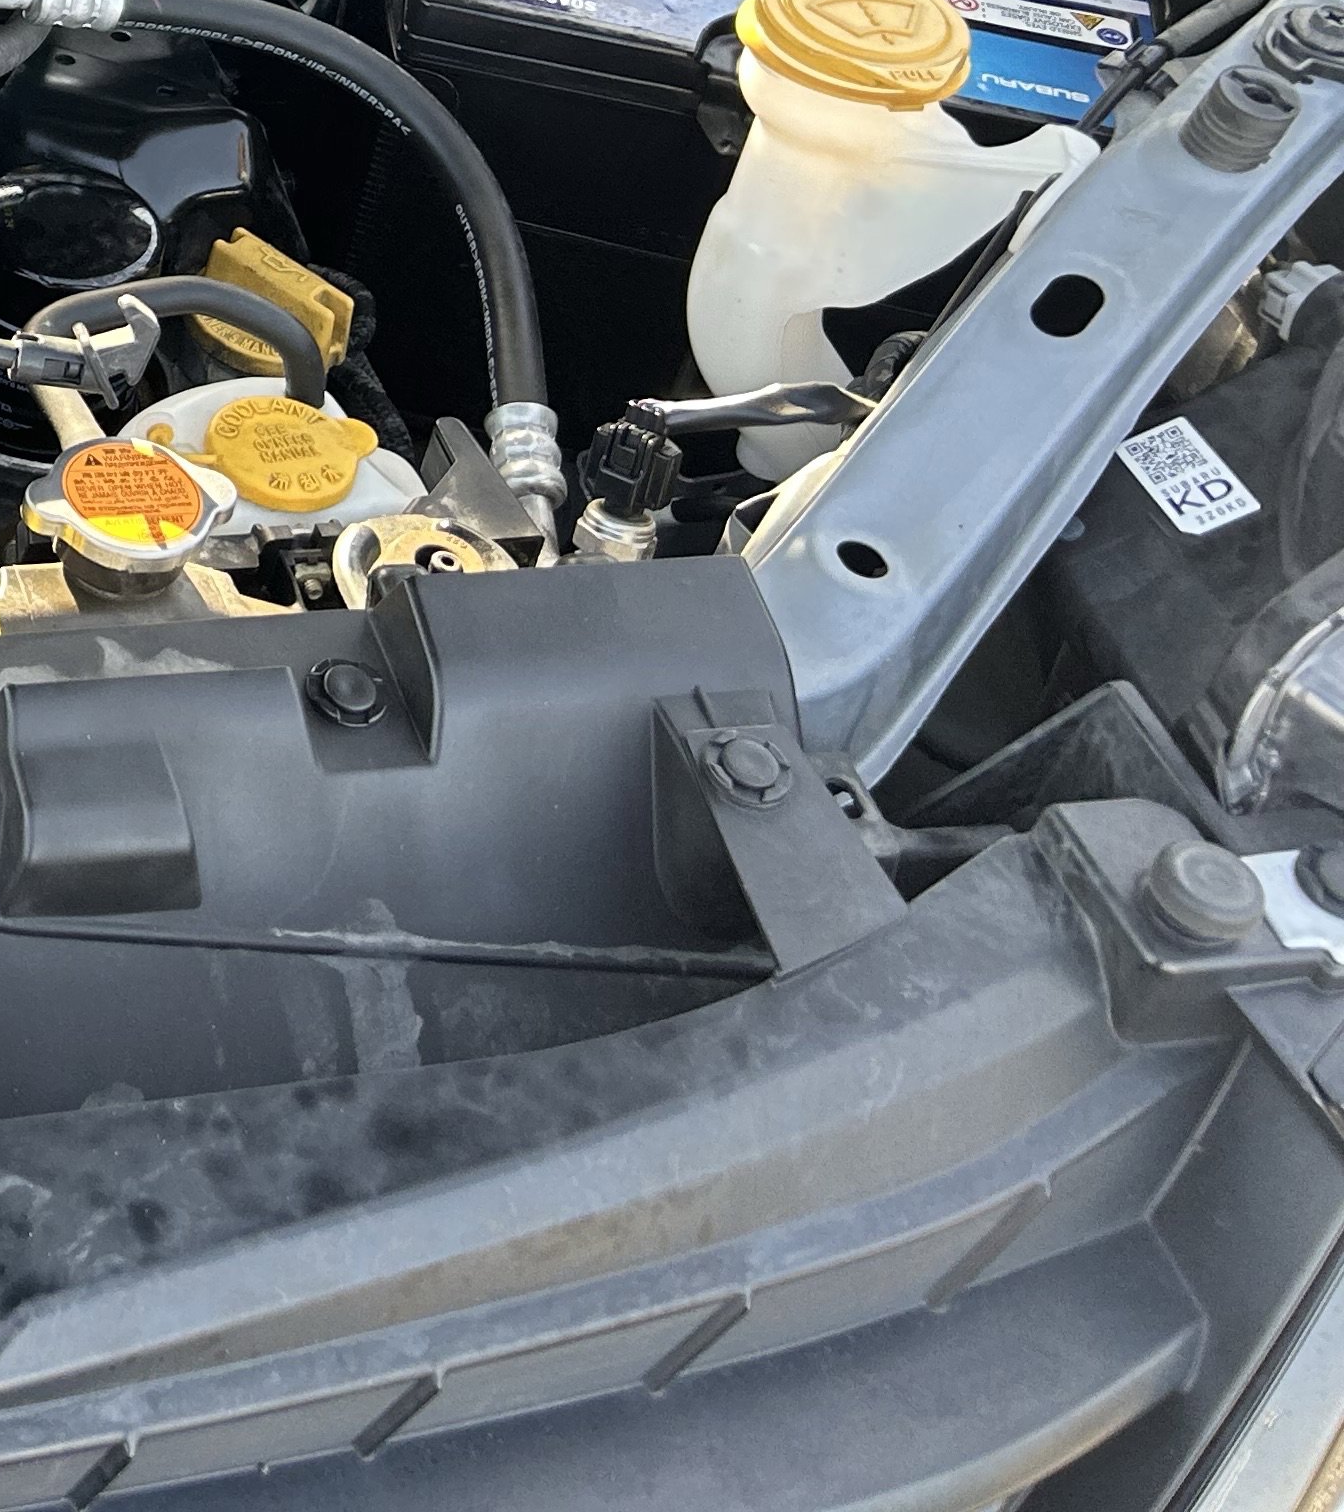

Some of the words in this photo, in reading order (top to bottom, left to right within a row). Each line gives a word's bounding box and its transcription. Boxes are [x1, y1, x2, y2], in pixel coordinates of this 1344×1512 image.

[980, 72, 1090, 104] SUBARU
[241, 338, 280, 357] MANU
[216, 399, 325, 438] COOLANT
[1161, 467, 1222, 498] SUBARU
[1166, 478, 1233, 517] KD
